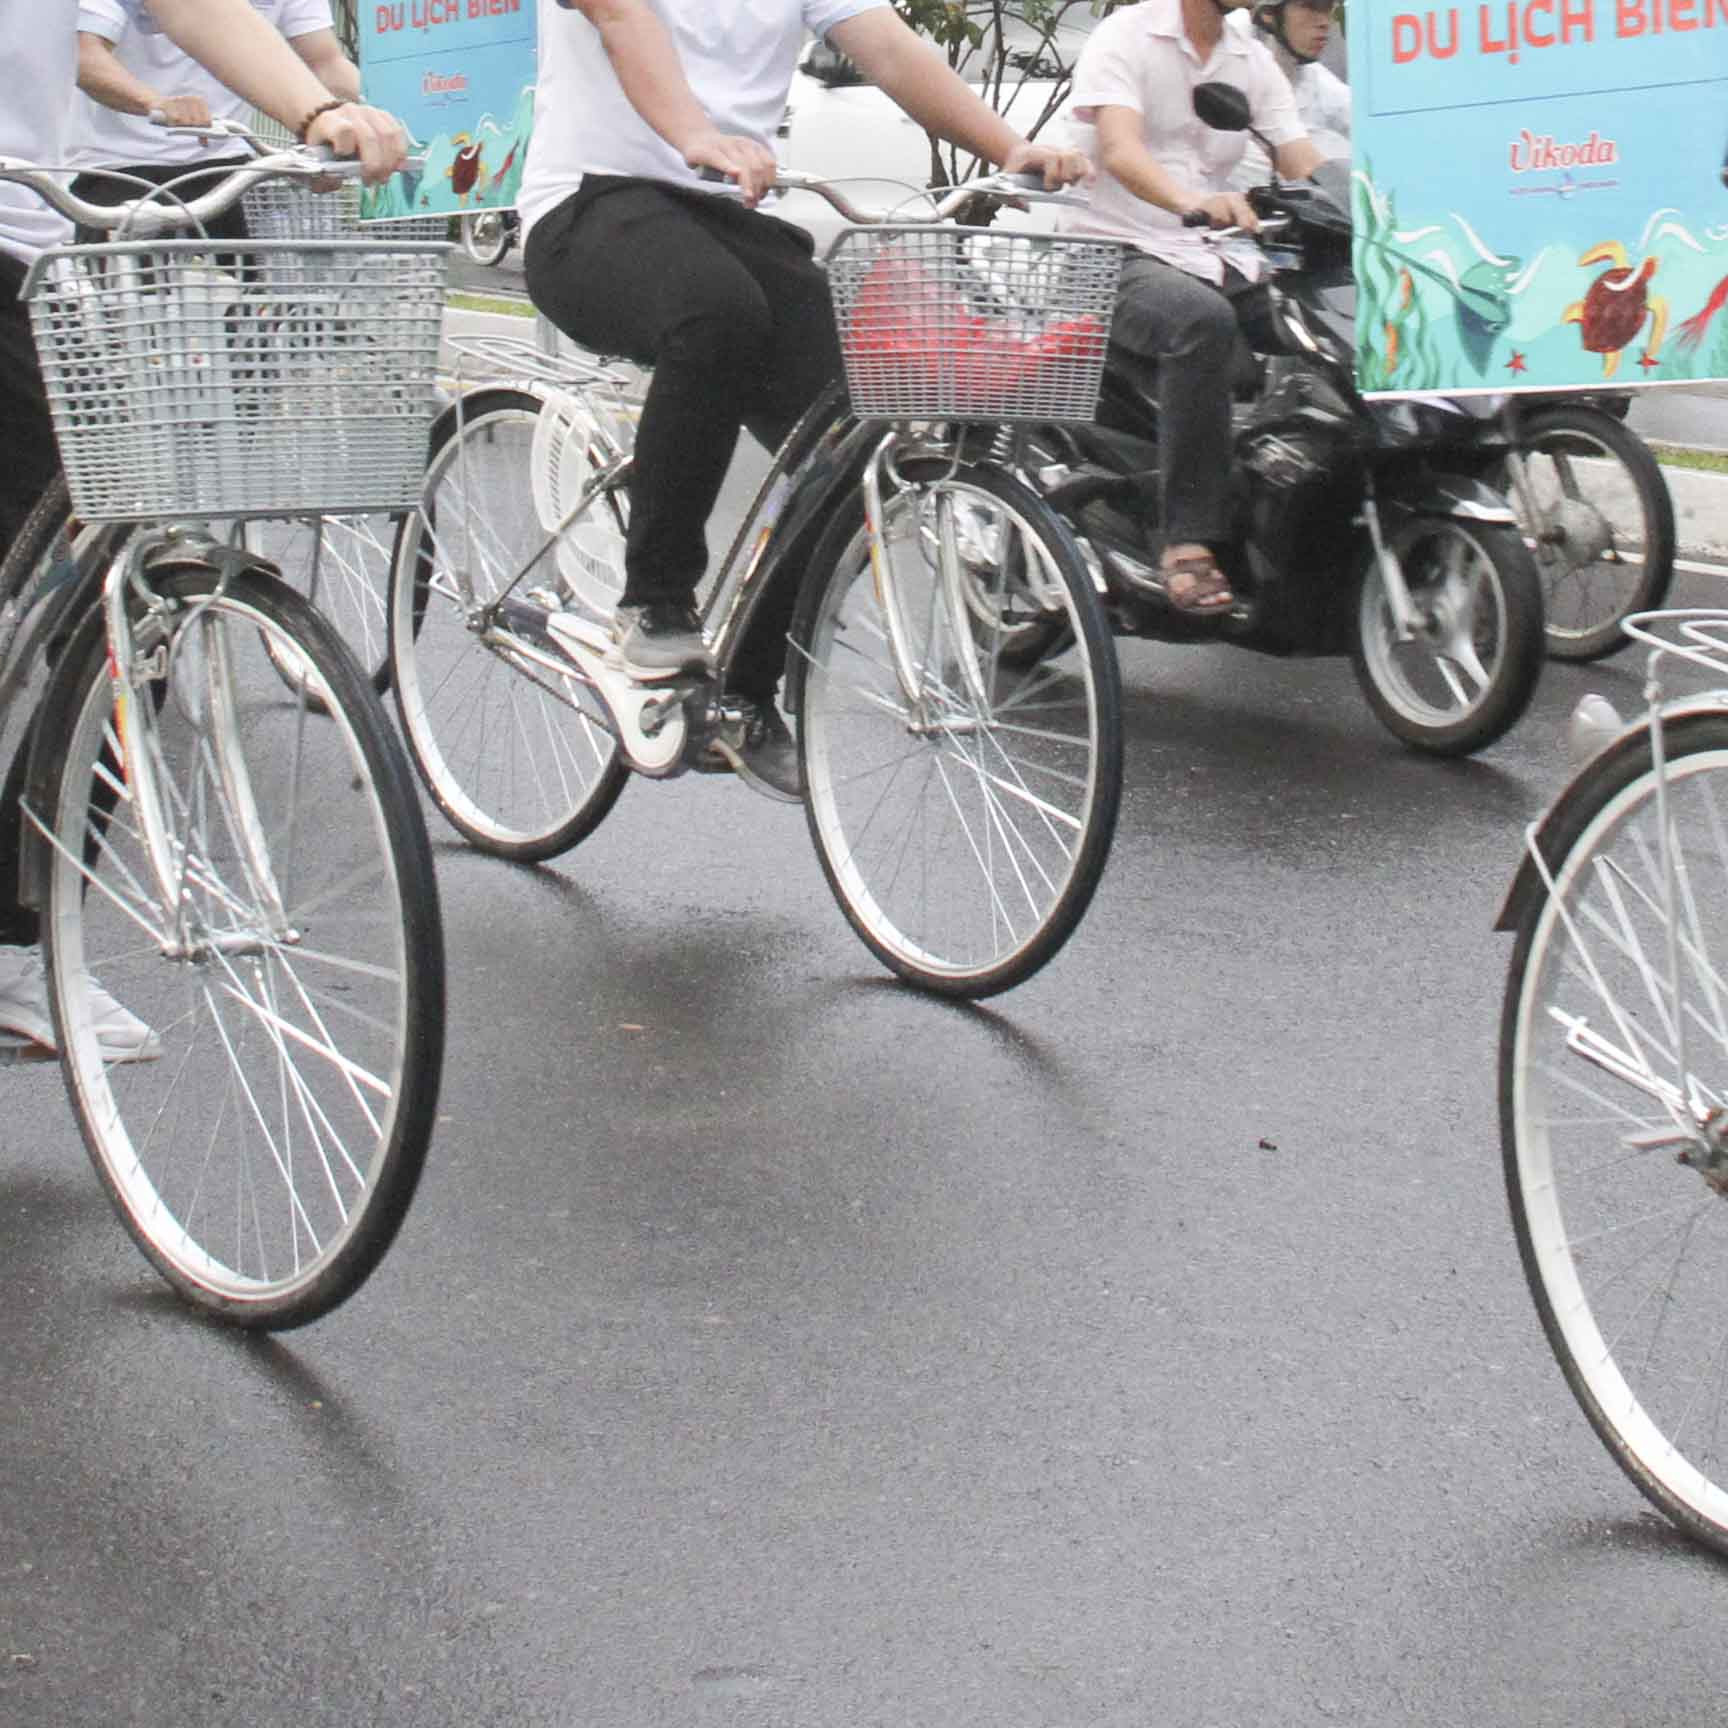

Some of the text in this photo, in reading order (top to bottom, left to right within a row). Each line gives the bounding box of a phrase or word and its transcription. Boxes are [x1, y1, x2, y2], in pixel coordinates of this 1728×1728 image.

[376, 2, 404, 34] DU
[1391, 7, 1461, 65] DU
[1508, 128, 1617, 173] Vikoda
